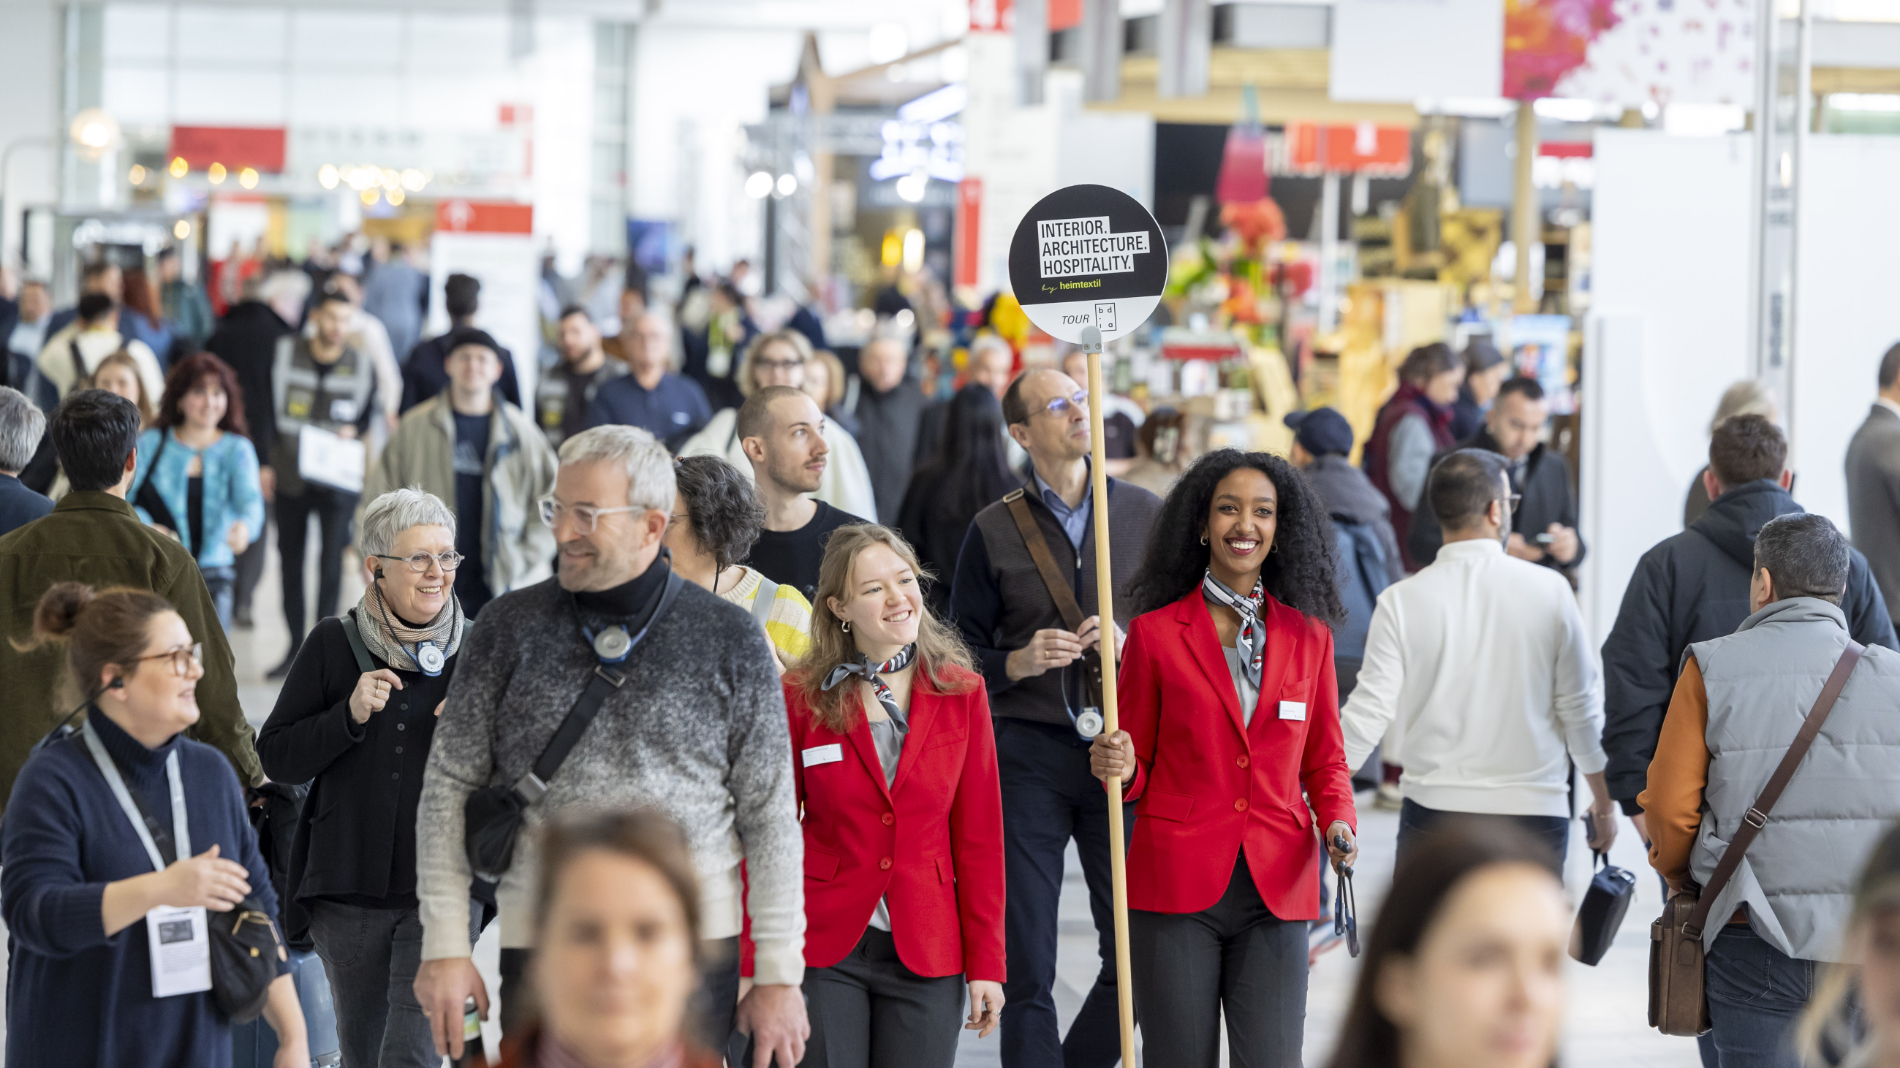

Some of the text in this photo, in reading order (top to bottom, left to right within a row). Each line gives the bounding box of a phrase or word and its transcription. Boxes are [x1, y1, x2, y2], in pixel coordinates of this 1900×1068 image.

[1041, 220, 1108, 238] INTERIOR.
[1042, 235, 1147, 257] ARCHITECTURE.
[1043, 255, 1131, 275] HOSPITALITY.
[1041, 279, 1101, 294] by heimtextil
[1061, 314, 1090, 325] TOUR
